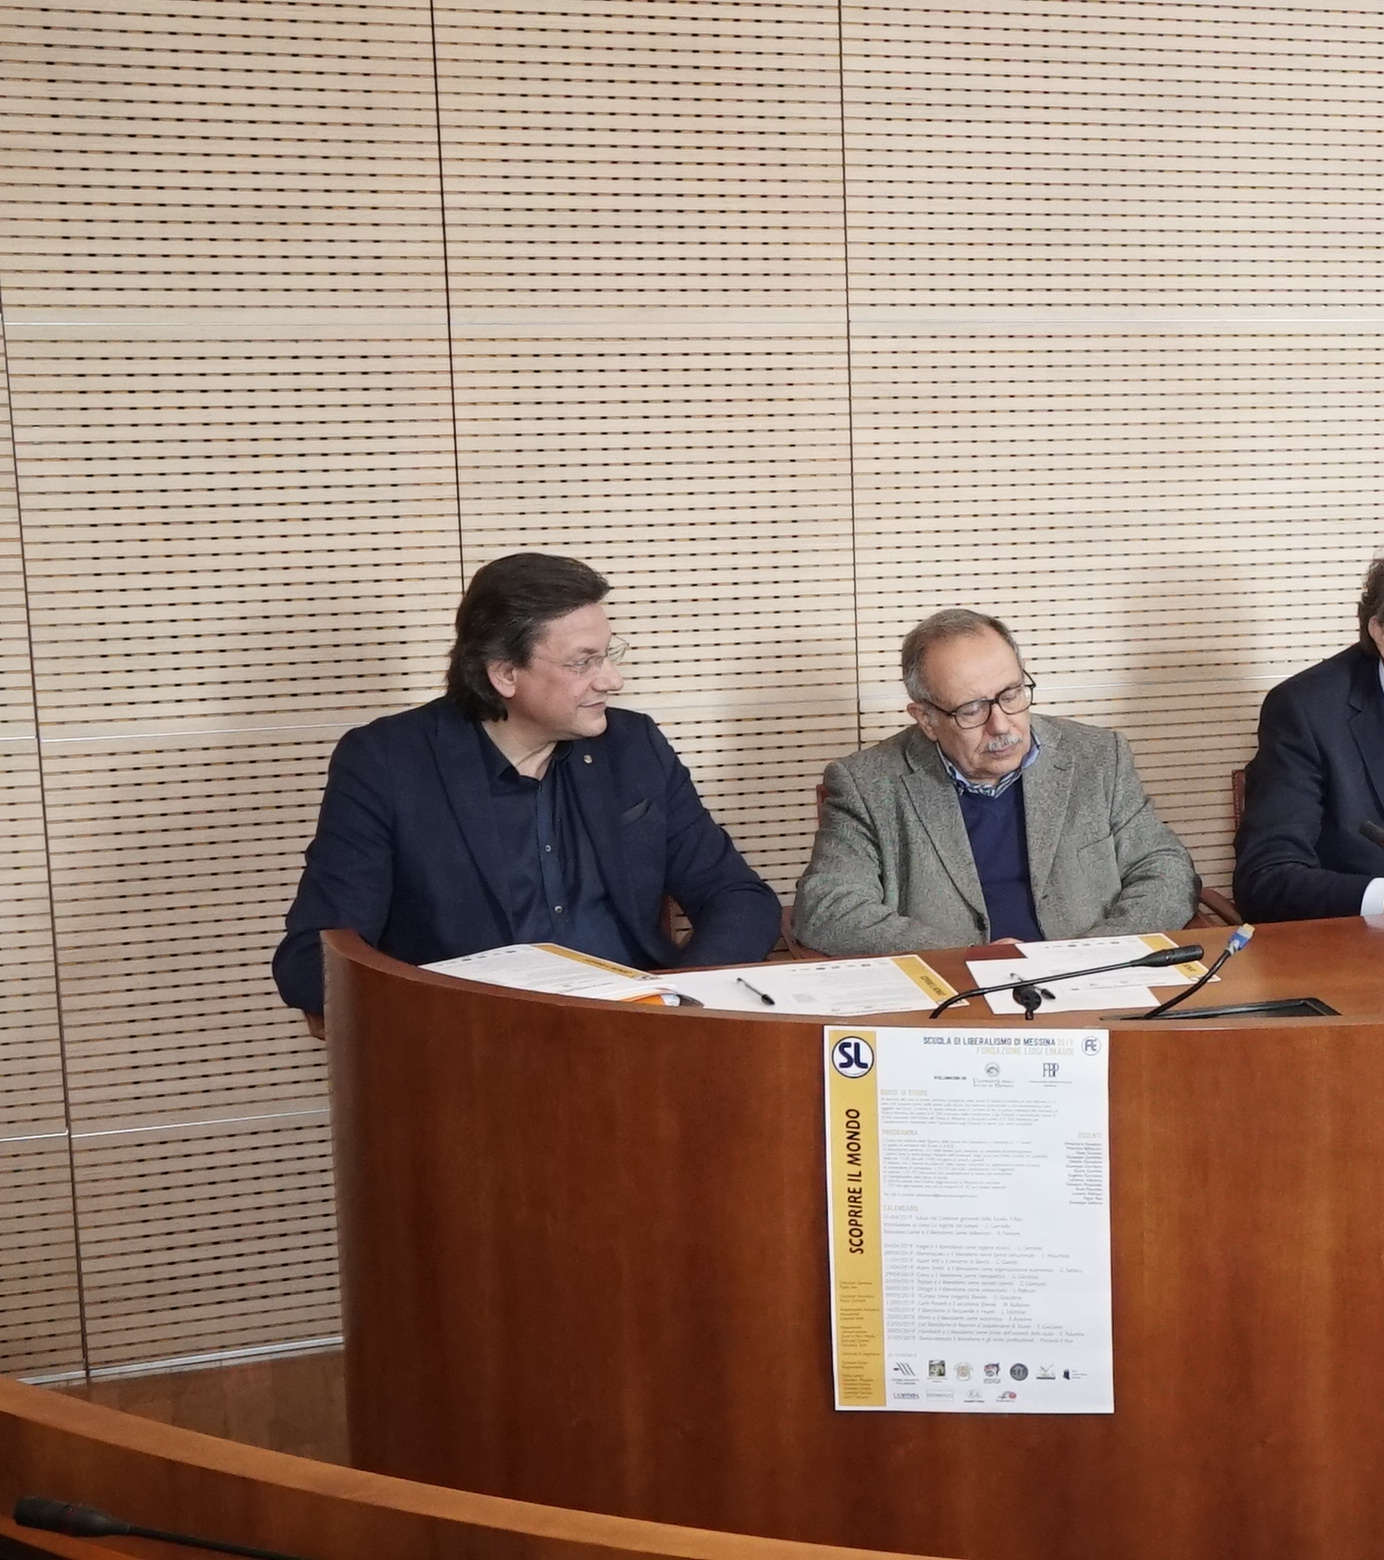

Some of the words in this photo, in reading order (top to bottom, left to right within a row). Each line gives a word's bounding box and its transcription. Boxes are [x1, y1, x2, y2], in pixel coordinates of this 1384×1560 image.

[923, 1036, 952, 1045] SCUOLA
[953, 1036, 961, 1046] DI
[962, 1037, 1012, 1046] LIBERALISMO
[1013, 1037, 1021, 1046] DI
[1023, 1037, 1056, 1047] MESSINA
[976, 1046, 1022, 1055] FONDAZIONE
[838, 1041, 869, 1070] SL
[845, 1108, 862, 1167] MONDO
[847, 1170, 863, 1183] IL
[847, 1187, 864, 1255] SCOPRIRE
